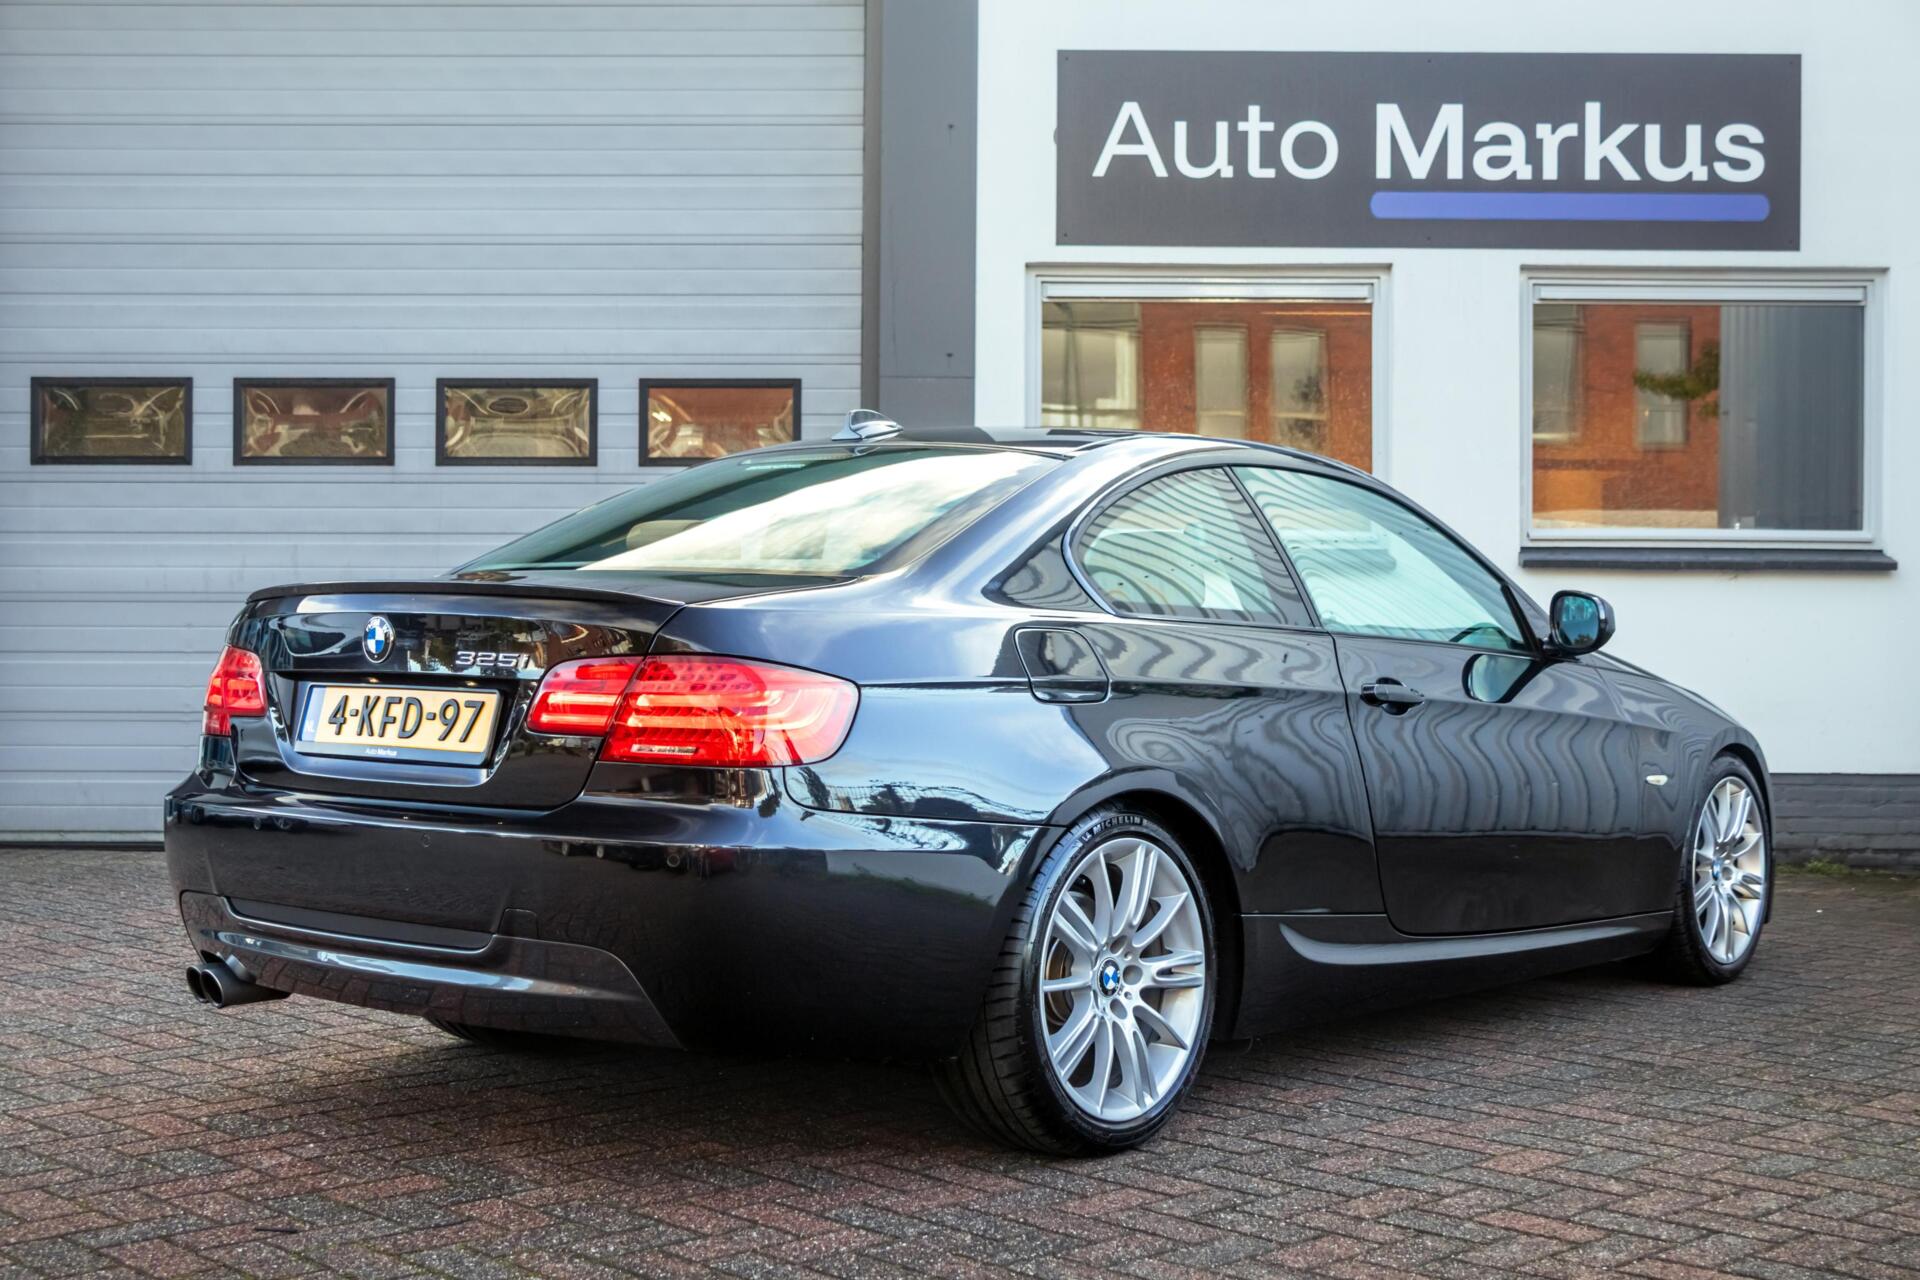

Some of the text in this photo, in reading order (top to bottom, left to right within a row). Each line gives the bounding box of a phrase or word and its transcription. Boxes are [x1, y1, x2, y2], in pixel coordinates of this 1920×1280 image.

[1092, 101, 1766, 182] Auto Markus
[456, 651, 530, 669] 325i
[328, 695, 485, 742] 4-KFD-97
[1093, 815, 1141, 835] MICHELIN
